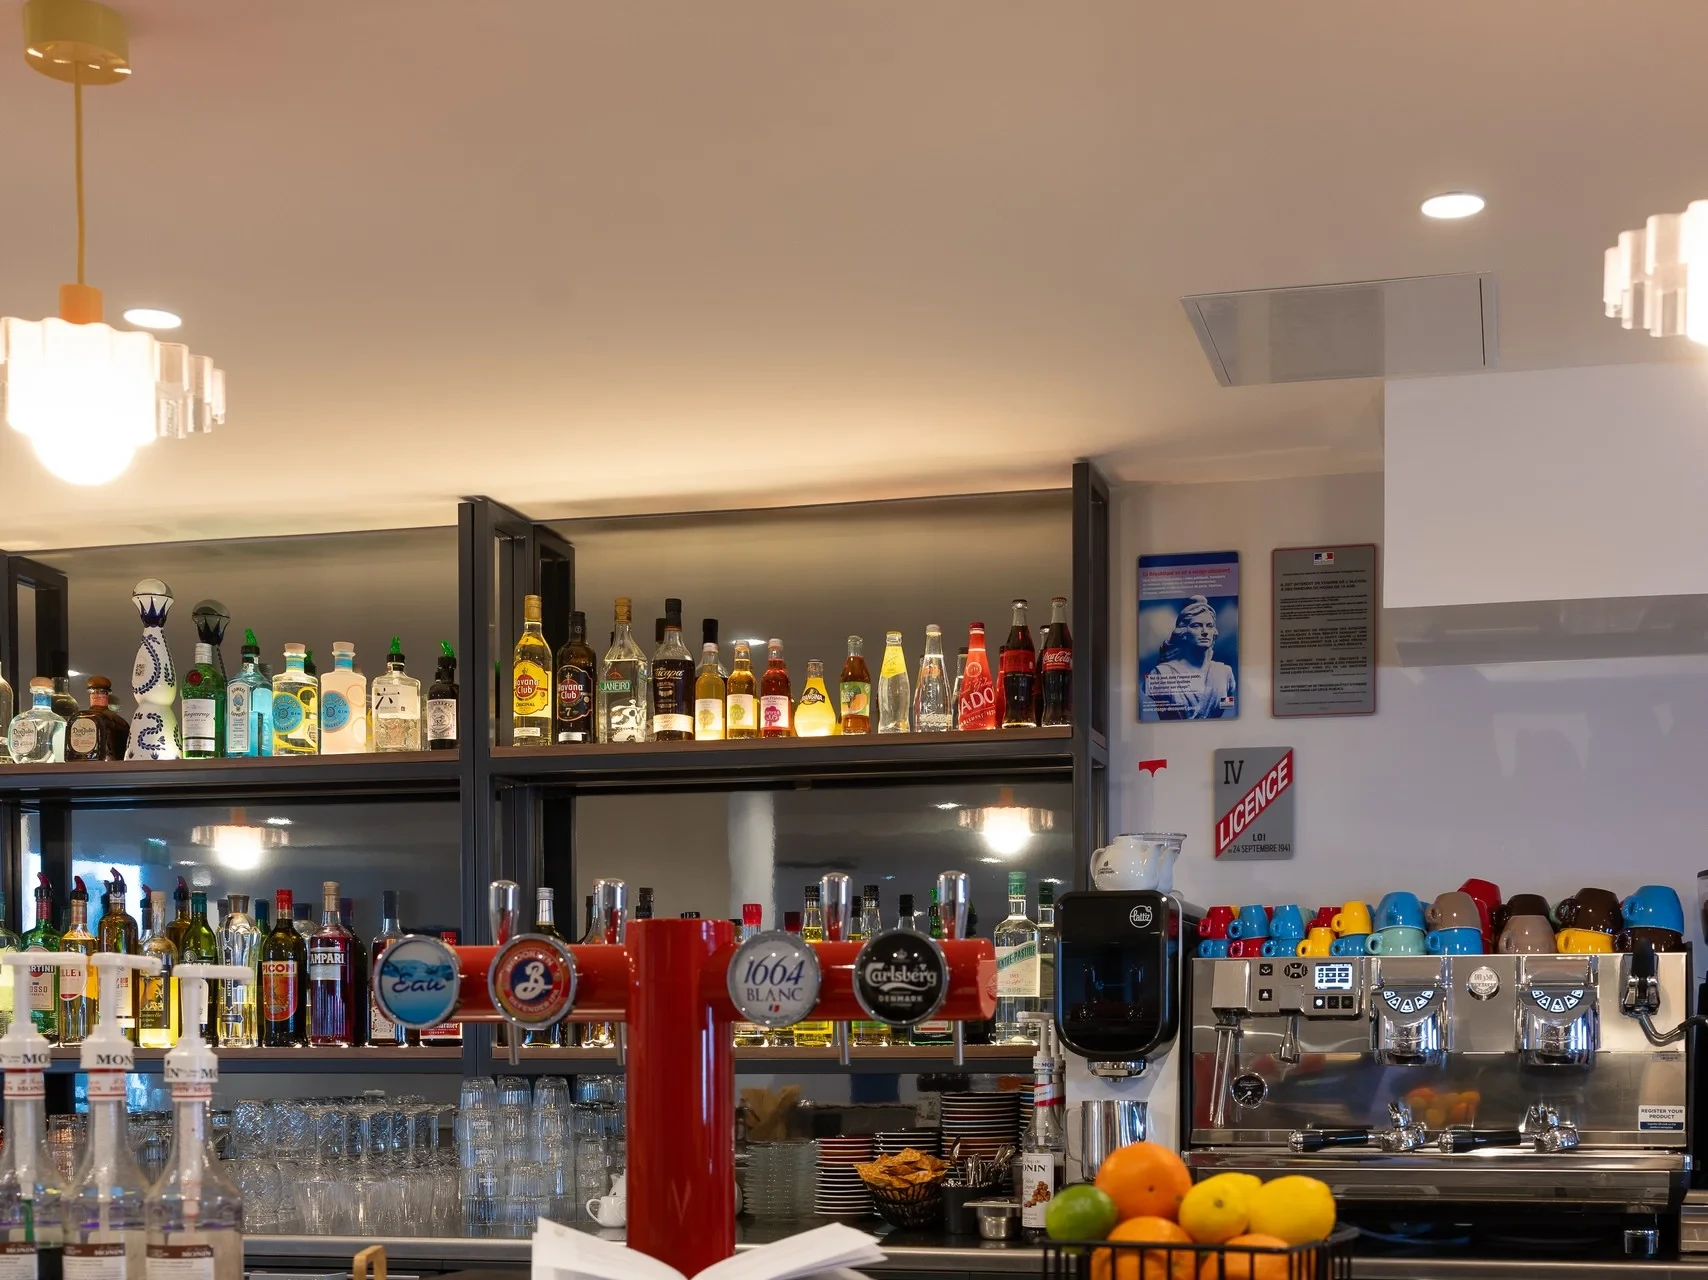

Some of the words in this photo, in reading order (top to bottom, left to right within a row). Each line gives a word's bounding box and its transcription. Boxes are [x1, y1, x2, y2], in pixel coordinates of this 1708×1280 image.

[517, 686, 533, 694] Club
[602, 682, 630, 690] JANEIRO
[560, 692, 577, 700] Club
[958, 687, 995, 716] ADO
[565, 708, 572, 716] 7
[1224, 760, 1244, 784] IV
[1220, 757, 1288, 850] LICENCE
[1252, 834, 1266, 842] LOI
[1232, 846, 1240, 854] 24
[1242, 844, 1278, 853] SEPTEMBRE
[1278, 844, 1291, 852] 1941
[311, 953, 345, 964] AMPARI
[744, 954, 806, 986] 1664
[865, 962, 938, 988] Carlsberg
[392, 972, 446, 993] Eau
[746, 987, 803, 1002] BLANC
[22, 1054, 48, 1066] MO
[1023, 1164, 1046, 1172] ONIN
